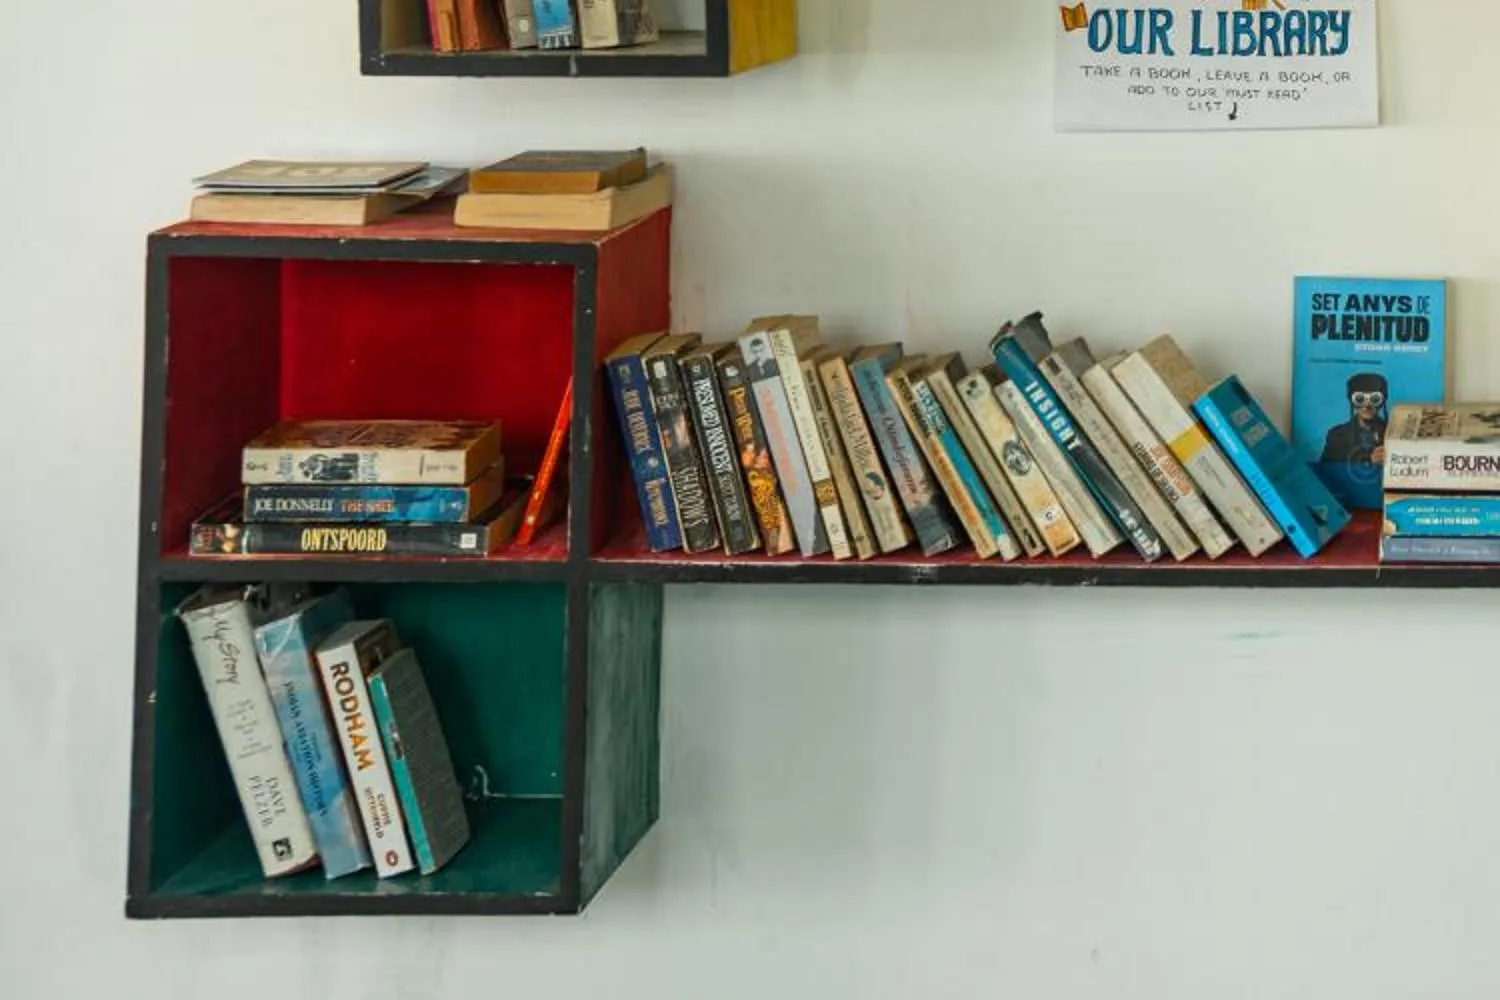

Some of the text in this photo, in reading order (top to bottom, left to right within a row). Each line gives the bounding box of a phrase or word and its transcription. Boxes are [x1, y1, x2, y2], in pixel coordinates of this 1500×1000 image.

[1087, 8, 1352, 57] OUR LIBRARY
[1080, 65, 1122, 77] TAKE
[1130, 67, 1141, 77] A
[1206, 70, 1251, 82] LEAVE
[1260, 71, 1269, 81] A
[1333, 72, 1351, 81] OR
[1127, 85, 1155, 96] ADD
[1163, 86, 1179, 96] TO
[1187, 86, 1217, 97] OUR
[1188, 101, 1224, 111] LIST
[1311, 293, 1431, 314] SET ANYS DE
[1311, 313, 1430, 342] PLENITUD
[692, 376, 721, 428] PRESUMED
[1023, 379, 1082, 453] INSIGHT
[704, 425, 733, 476] INNOCENT
[1390, 452, 1429, 465] Robert
[1389, 465, 1430, 479] Ludlum
[255, 498, 274, 513] JOE
[276, 498, 334, 512] DONNELLY
[671, 464, 710, 529] SHADOWS
[301, 527, 387, 551] ONTSPOORD
[328, 660, 376, 772] RODHAM
[247, 773, 276, 827] PELZER
[264, 776, 287, 816] DAVE
